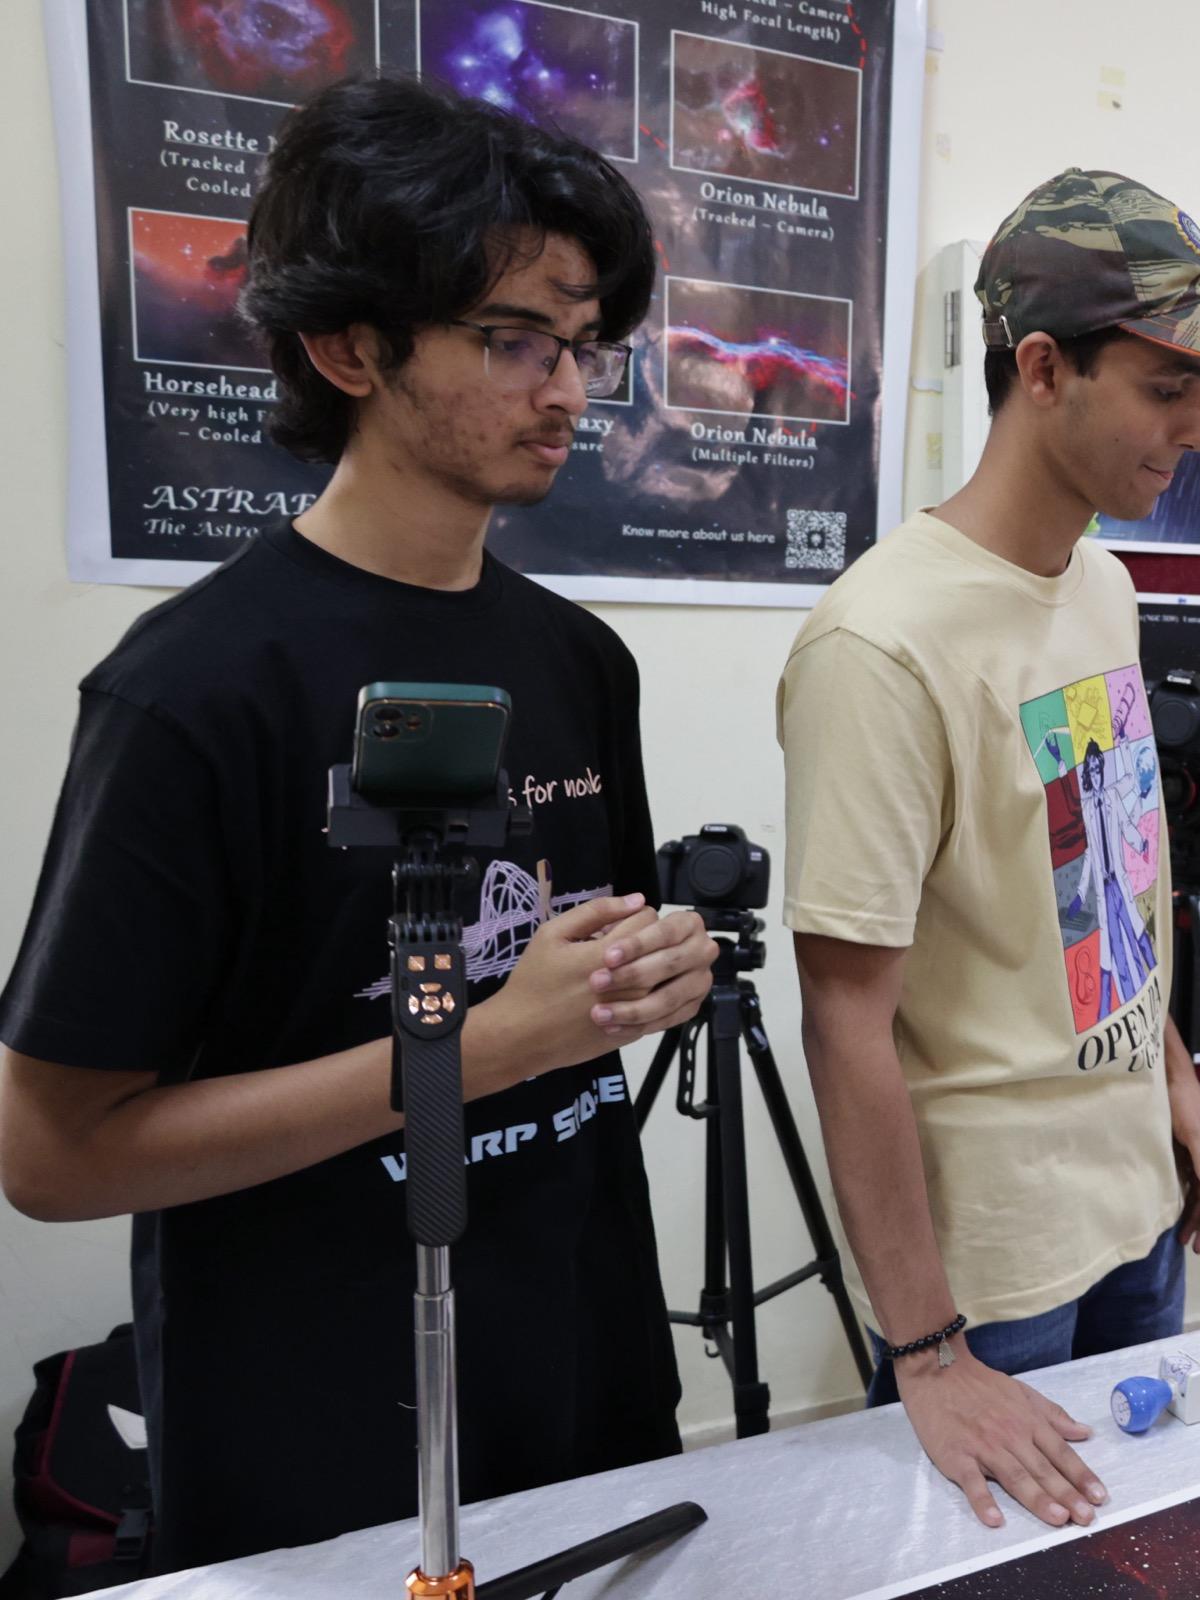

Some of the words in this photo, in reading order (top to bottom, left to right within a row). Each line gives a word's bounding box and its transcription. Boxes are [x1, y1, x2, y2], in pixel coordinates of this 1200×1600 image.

[701, 1, 737, 21] High
[743, 9, 781, 29] Focal
[787, 18, 841, 44] Length)
[799, 1, 850, 25] Camera
[163, 120, 259, 152] Rosette
[160, 149, 246, 175] (Tracked
[186, 177, 252, 198] Cooled
[700, 182, 756, 208] Orion
[761, 191, 829, 219] Nebula
[691, 206, 756, 229] (Tracked
[776, 220, 835, 243] Camera)
[144, 371, 278, 400] Horsehead
[147, 401, 200, 422] (Very
[208, 404, 249, 425] high
[198, 427, 262, 443] Cooled
[579, 417, 615, 437] axy
[690, 422, 746, 442] Orion
[752, 427, 817, 450] Nebula
[692, 446, 759, 466] (Multiple
[763, 453, 815, 470] Filters)
[143, 485, 317, 516] ASTRAE
[144, 517, 186, 536] The
[193, 520, 259, 539] Astro
[622, 524, 654, 538] Know
[657, 528, 689, 540] more
[692, 528, 727, 542] about
[731, 533, 744, 542] us
[747, 531, 775, 544] here
[522, 775, 558, 809] for
[553, 1074, 625, 1143] SAE
